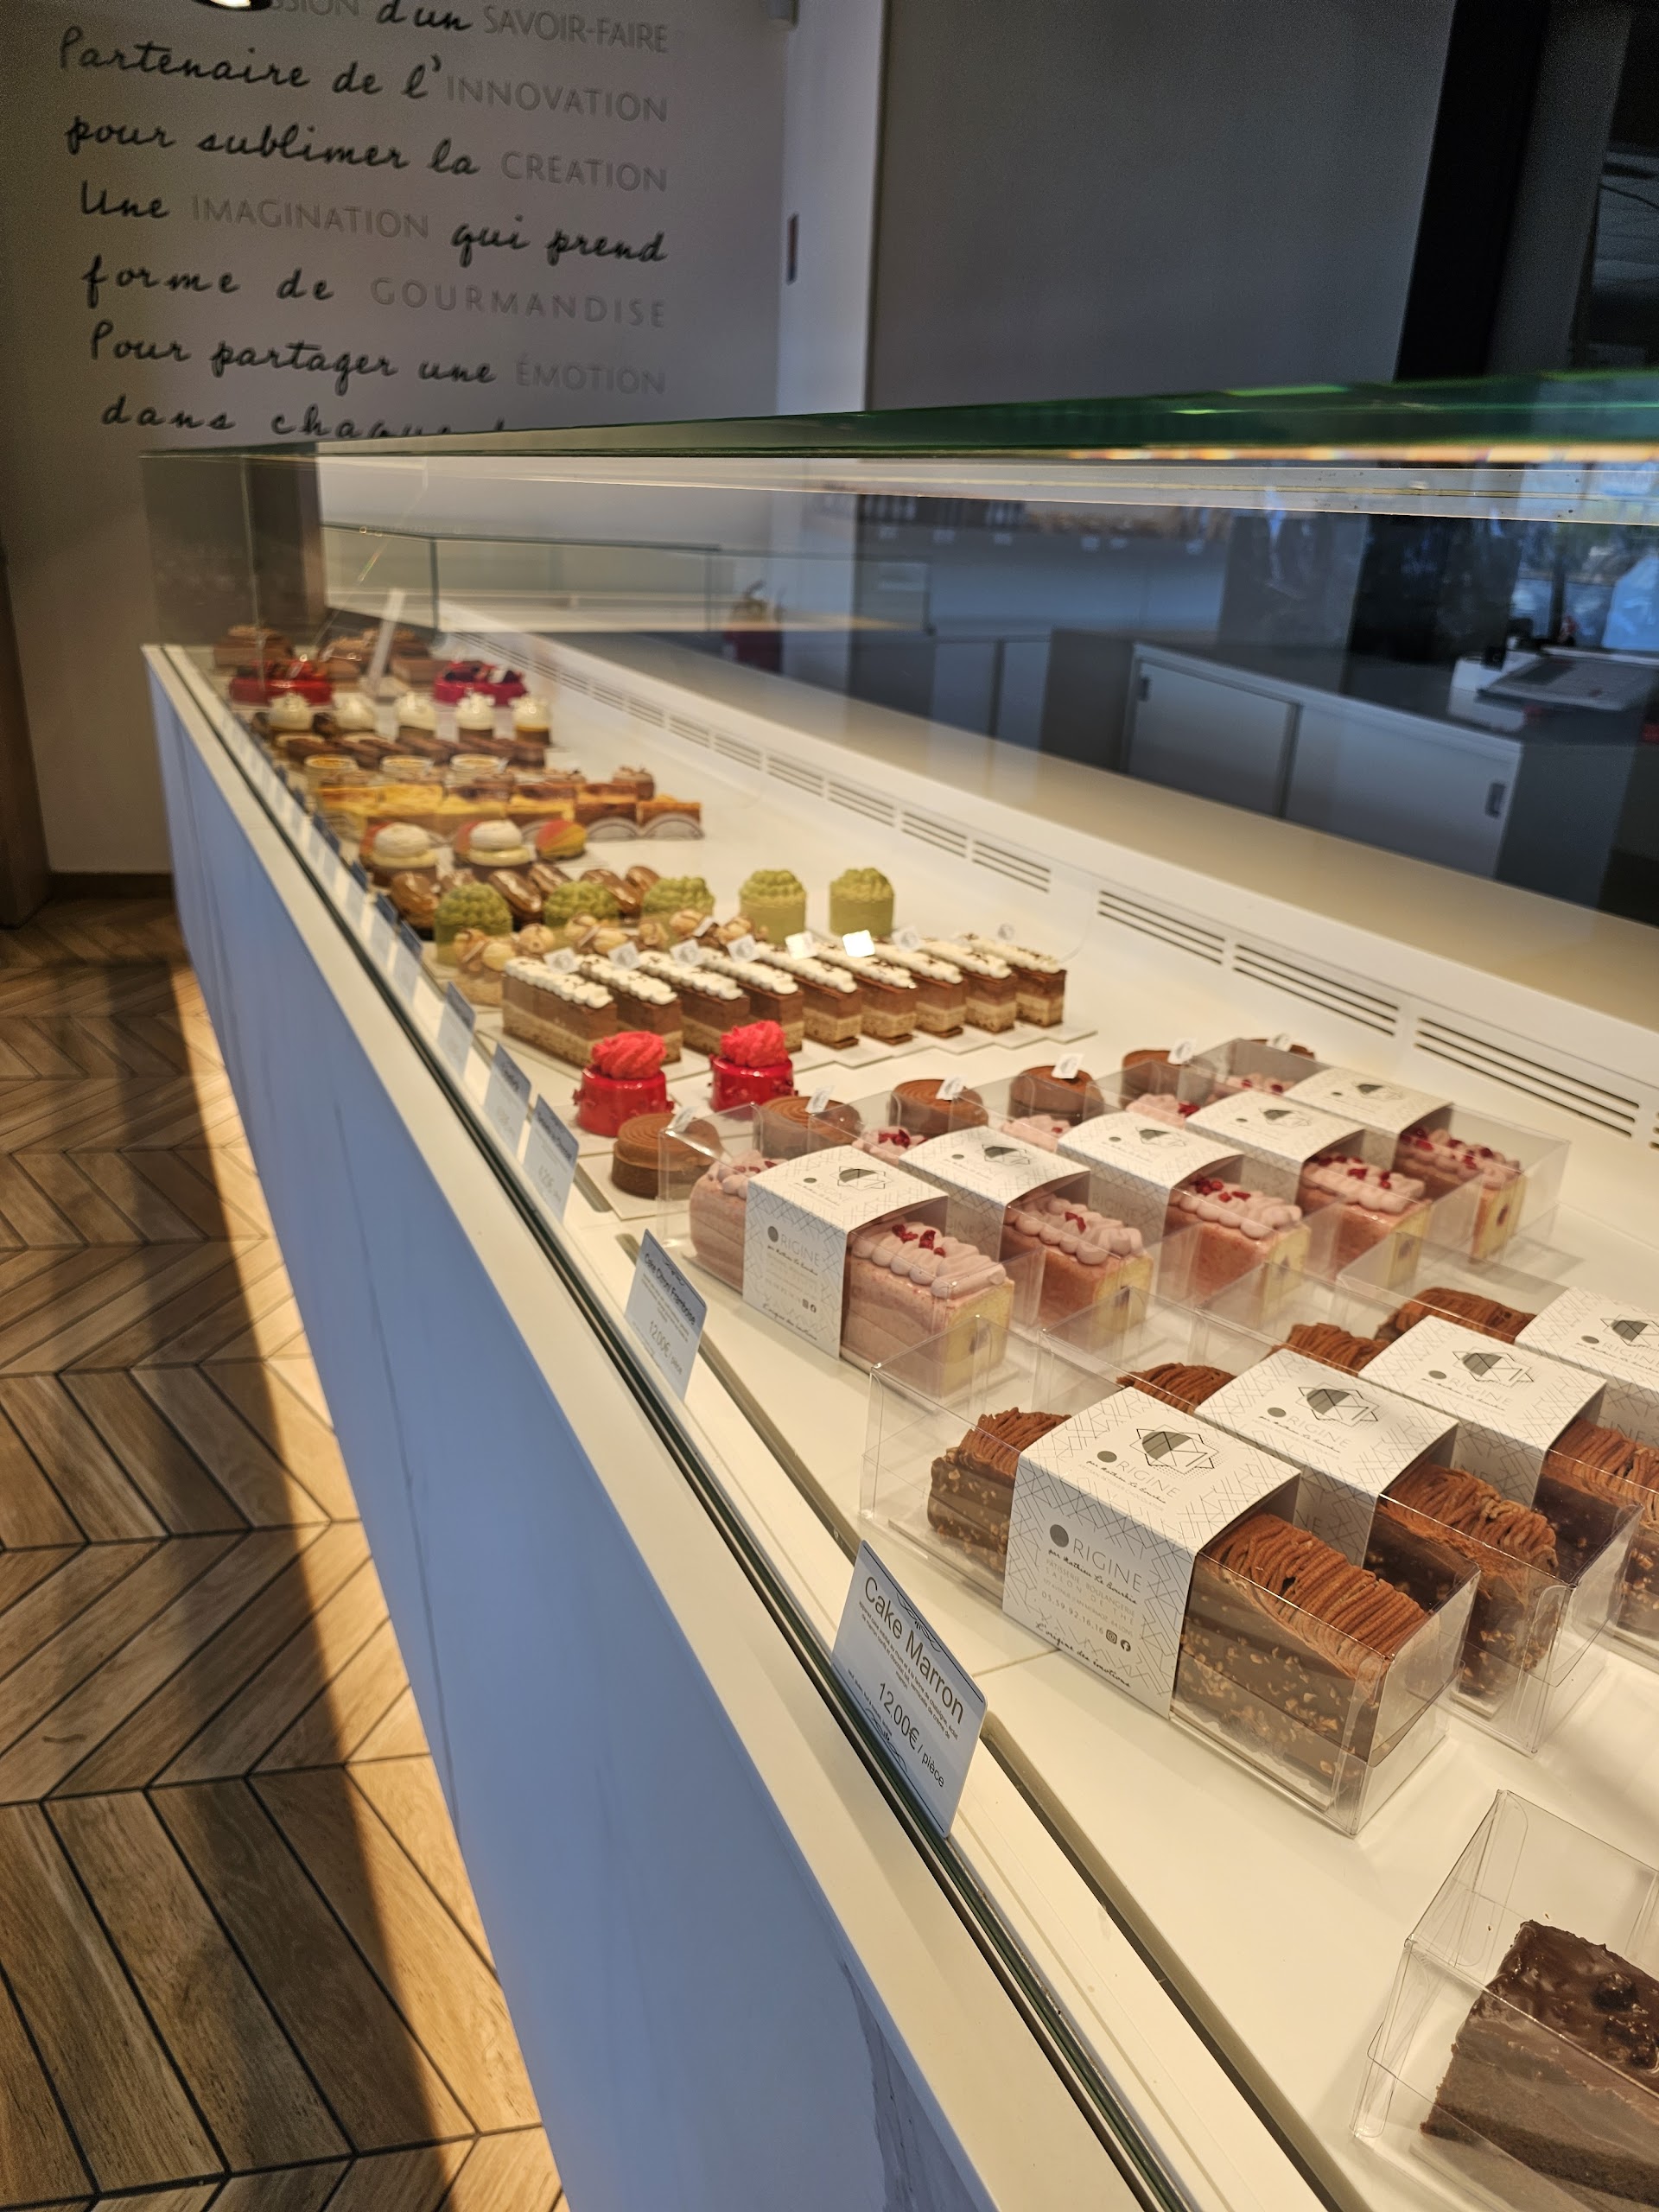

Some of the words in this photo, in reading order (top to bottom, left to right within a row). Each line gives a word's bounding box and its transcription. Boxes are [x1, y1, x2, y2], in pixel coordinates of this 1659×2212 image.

[59, 26, 309, 87] Partenaire
[332, 58, 383, 95] de
[482, 8, 670, 54] SAVOIR-FAIRE
[65, 113, 176, 154] pour
[197, 126, 410, 169] sublimer
[432, 139, 480, 176] la
[81, 180, 169, 218] Une
[191, 194, 429, 238] IMAGINATION
[451, 215, 530, 266] qui
[548, 229, 668, 266] prend
[83, 256, 240, 308] forme
[276, 269, 335, 301] de
[370, 276, 666, 328] GOURMANDISE
[89, 321, 191, 362] Pour
[210, 340, 397, 396] partager
[419, 358, 495, 385] une
[516, 354, 666, 396] ÉMOTION
[102, 397, 236, 432] dans
[1085, 1582, 1135, 1618] BOULANGERIE
[865, 1576, 903, 1639] Cake
[906, 1630, 963, 1724] Marron
[880, 1683, 919, 1750] 12.00€
[921, 1752, 944, 1788] pièce
